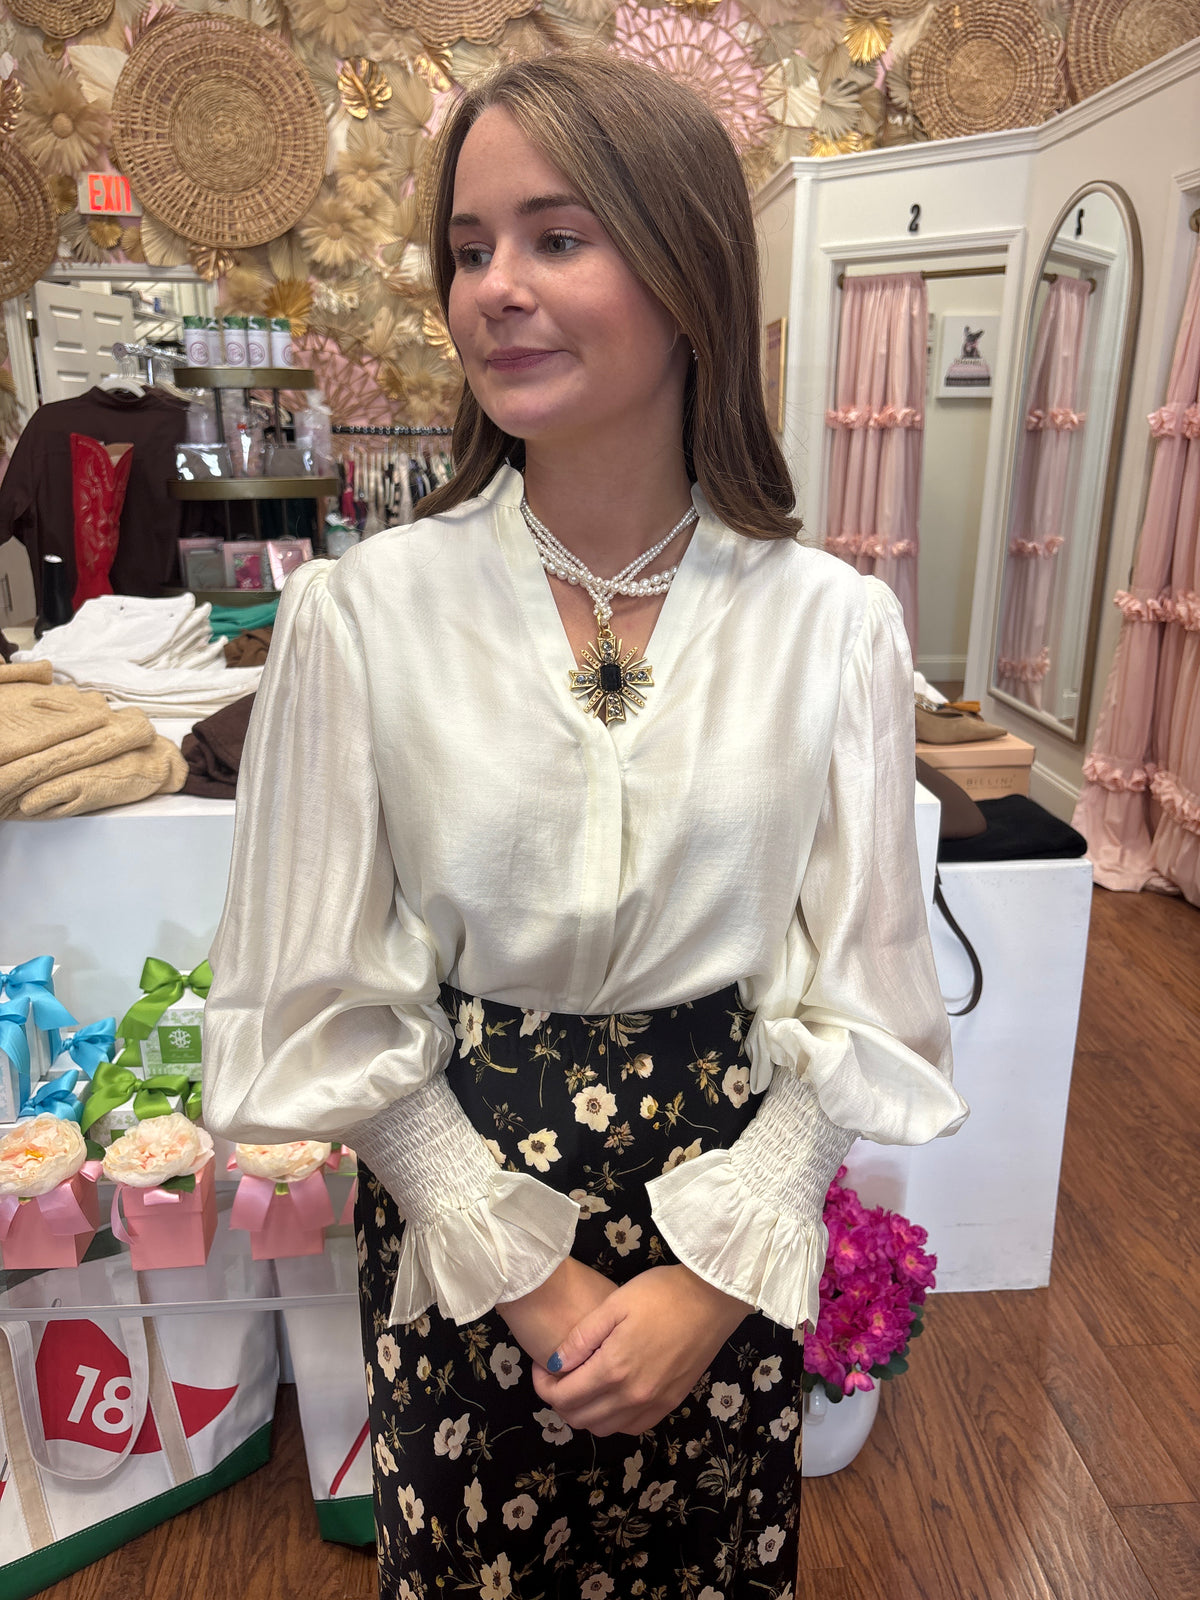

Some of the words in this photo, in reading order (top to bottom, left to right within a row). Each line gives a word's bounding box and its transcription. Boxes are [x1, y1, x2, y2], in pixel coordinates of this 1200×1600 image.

[88, 174, 132, 213] EXIT
[909, 204, 921, 232] 2
[67, 1364, 133, 1434] 18
